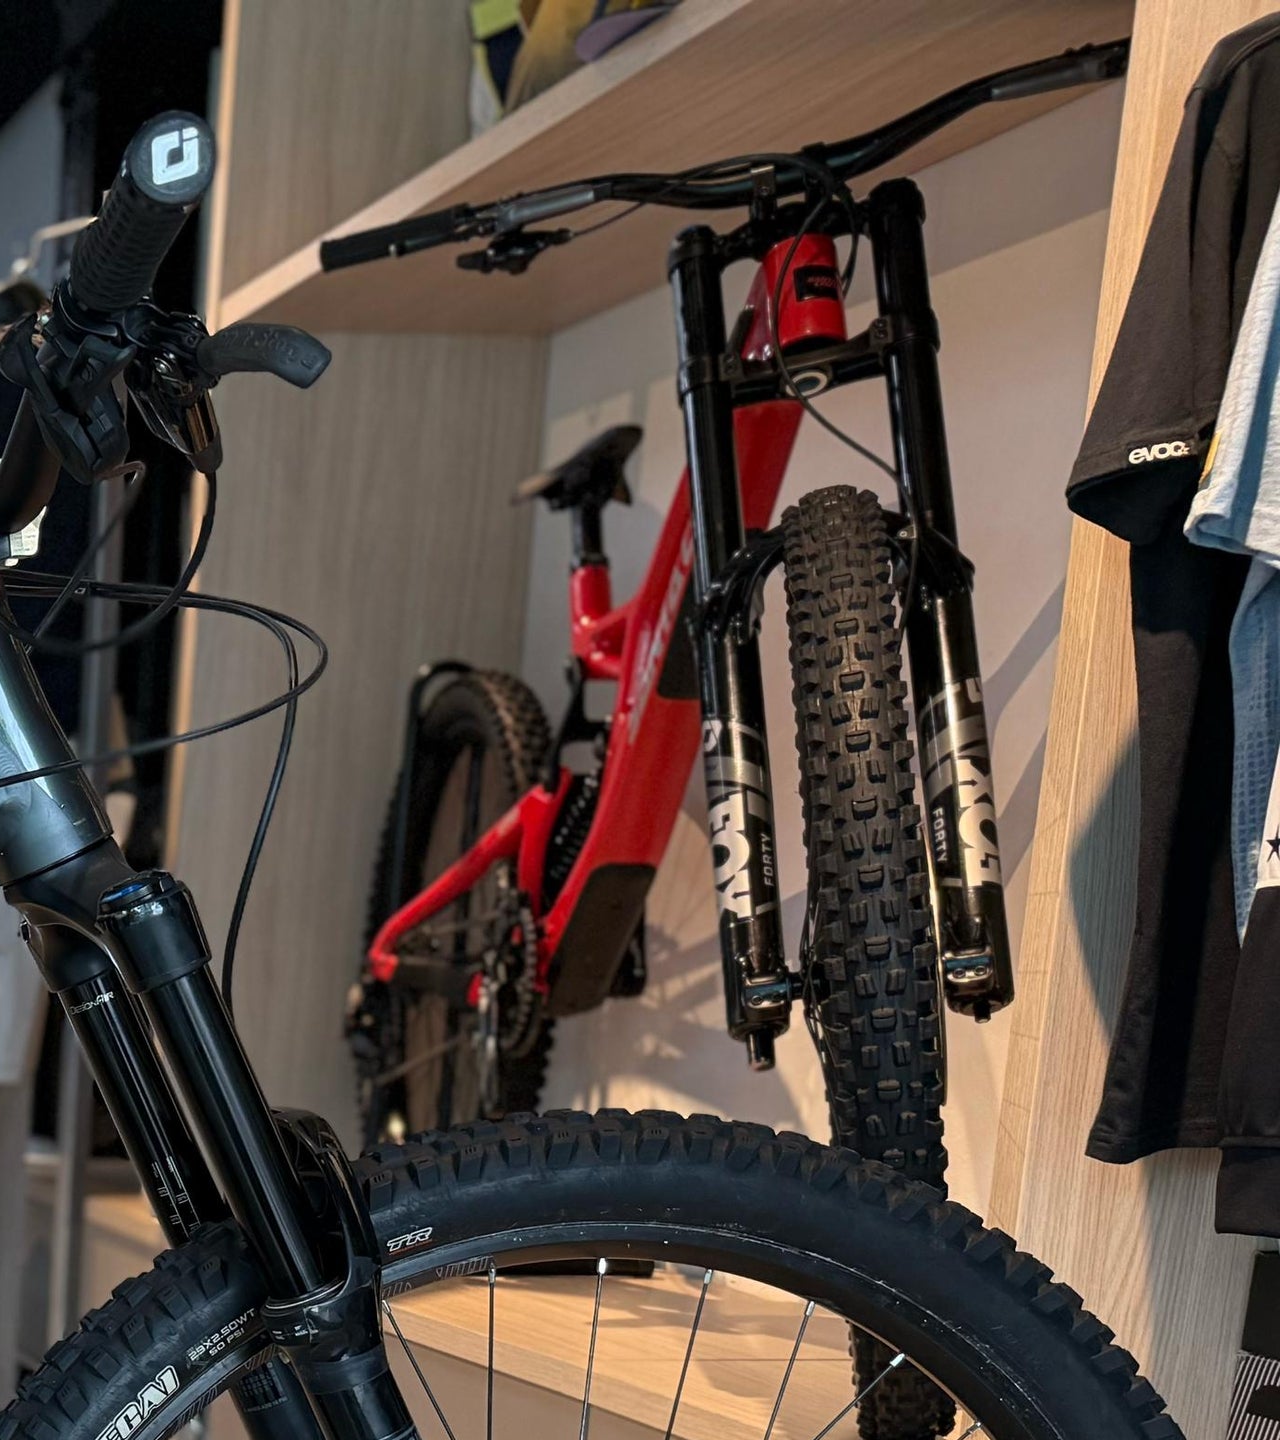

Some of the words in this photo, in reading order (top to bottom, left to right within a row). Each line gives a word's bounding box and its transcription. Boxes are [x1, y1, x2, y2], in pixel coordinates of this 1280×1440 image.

[932, 808, 949, 863] FORTY
[760, 832, 775, 887] FORTY
[386, 1226, 433, 1252] TR
[208, 1341, 226, 1357] 50
[226, 1328, 246, 1345] PSI
